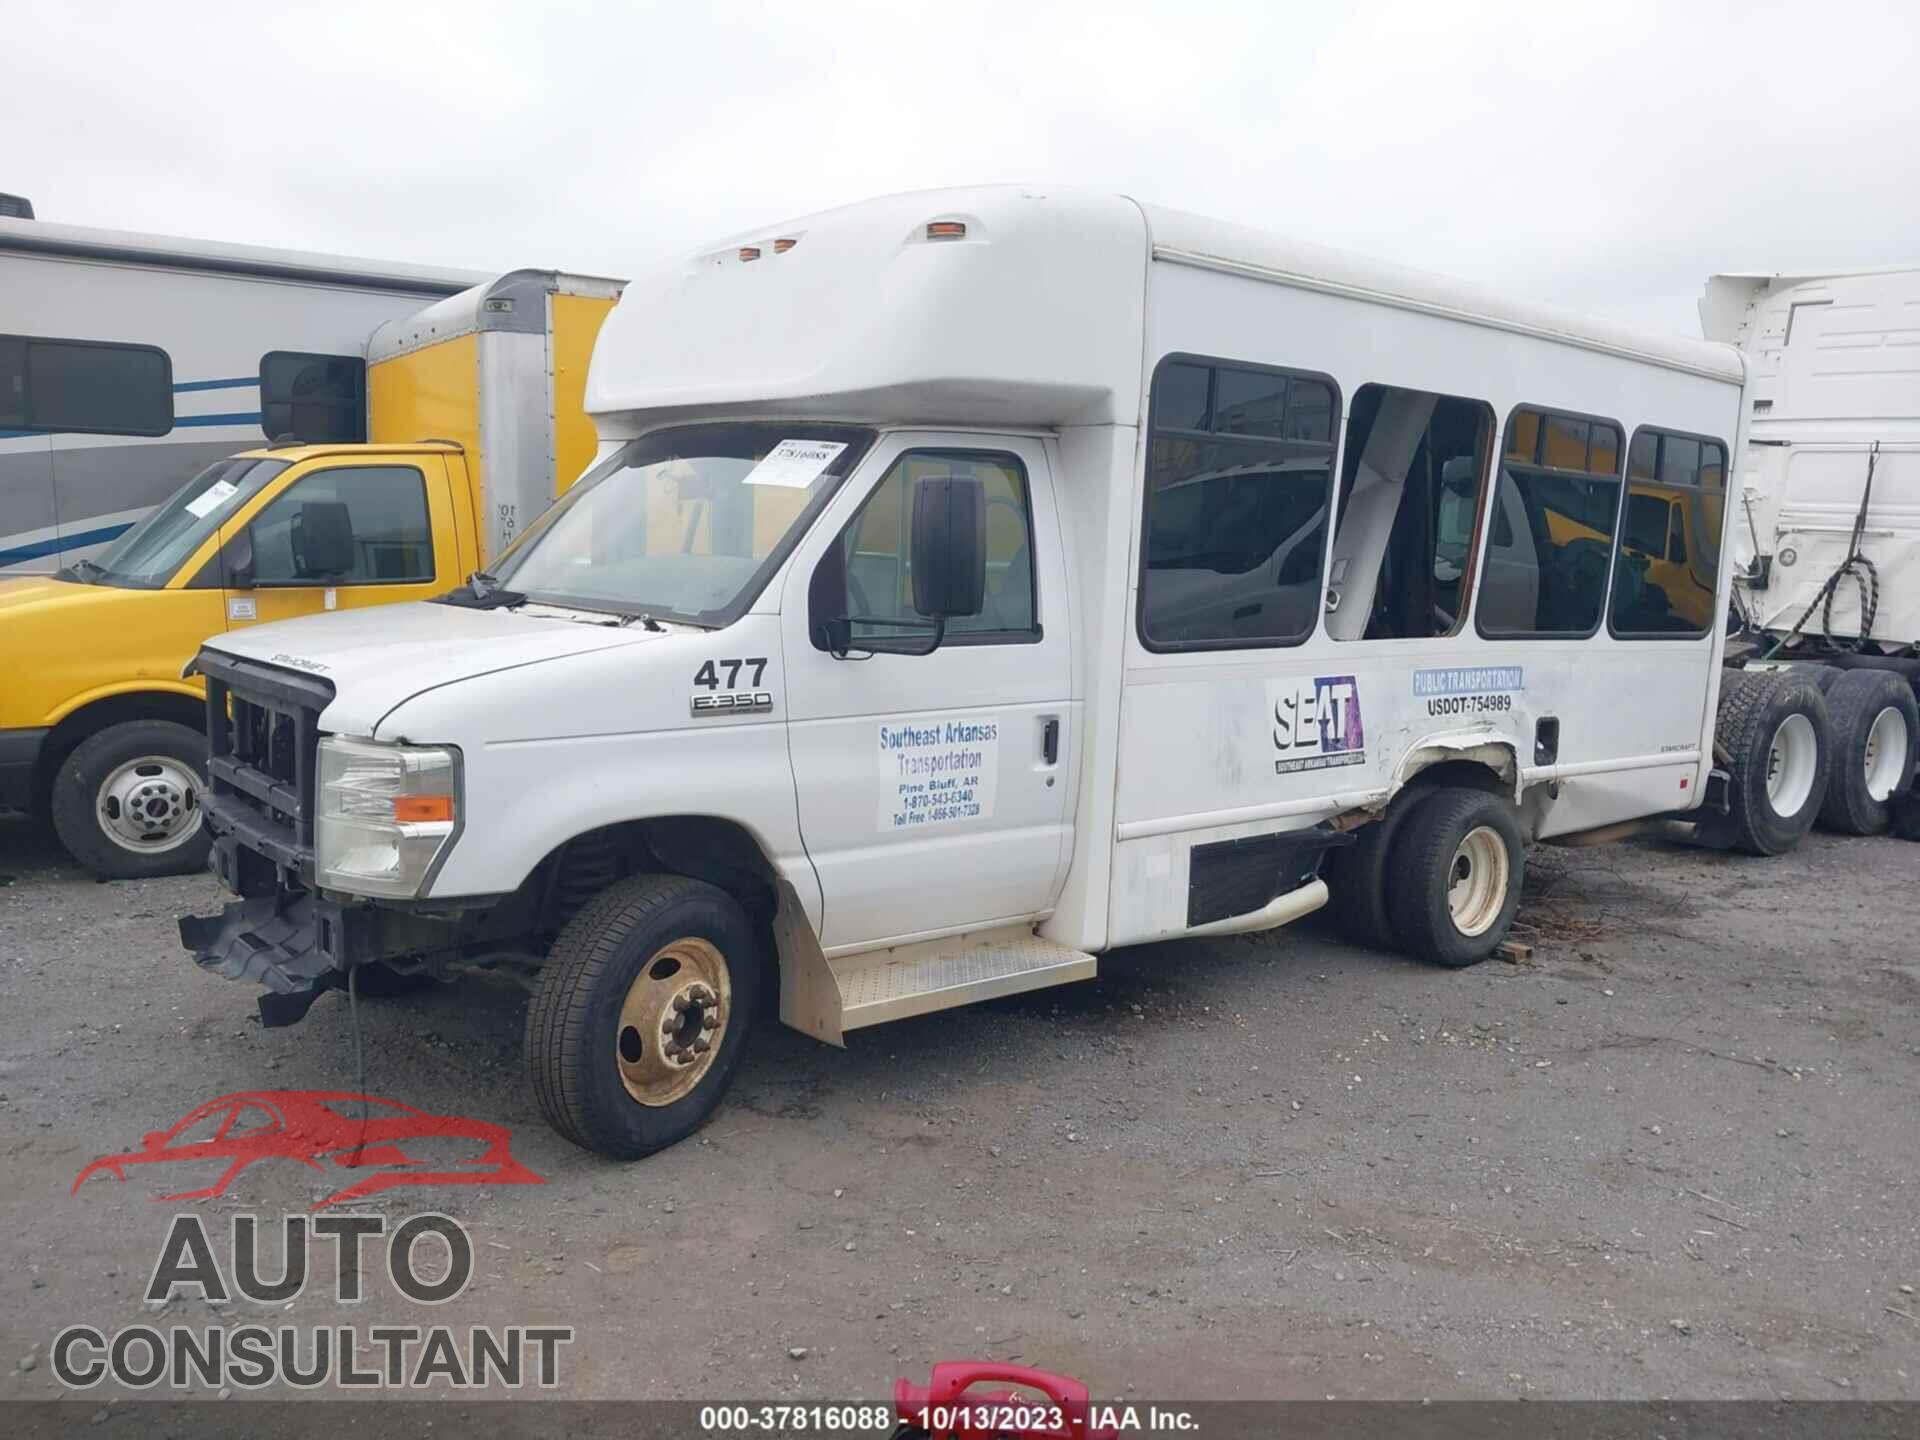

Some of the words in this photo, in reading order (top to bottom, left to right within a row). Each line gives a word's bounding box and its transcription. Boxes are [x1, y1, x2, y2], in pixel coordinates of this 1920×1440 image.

[694, 658, 767, 690] 477
[1415, 672, 1446, 692] PUBLIC
[1448, 669, 1520, 691] TRANSPORTATION
[1273, 684, 1353, 750] SEAT
[880, 725, 941, 749] Southeast
[945, 720, 997, 743] Arkansas
[897, 748, 982, 777] Transportation
[899, 783, 924, 794] Pine
[929, 778, 958, 790] Bluff,
[963, 776, 978, 786] AR
[894, 813, 907, 827] Toll
[909, 811, 925, 824] Free
